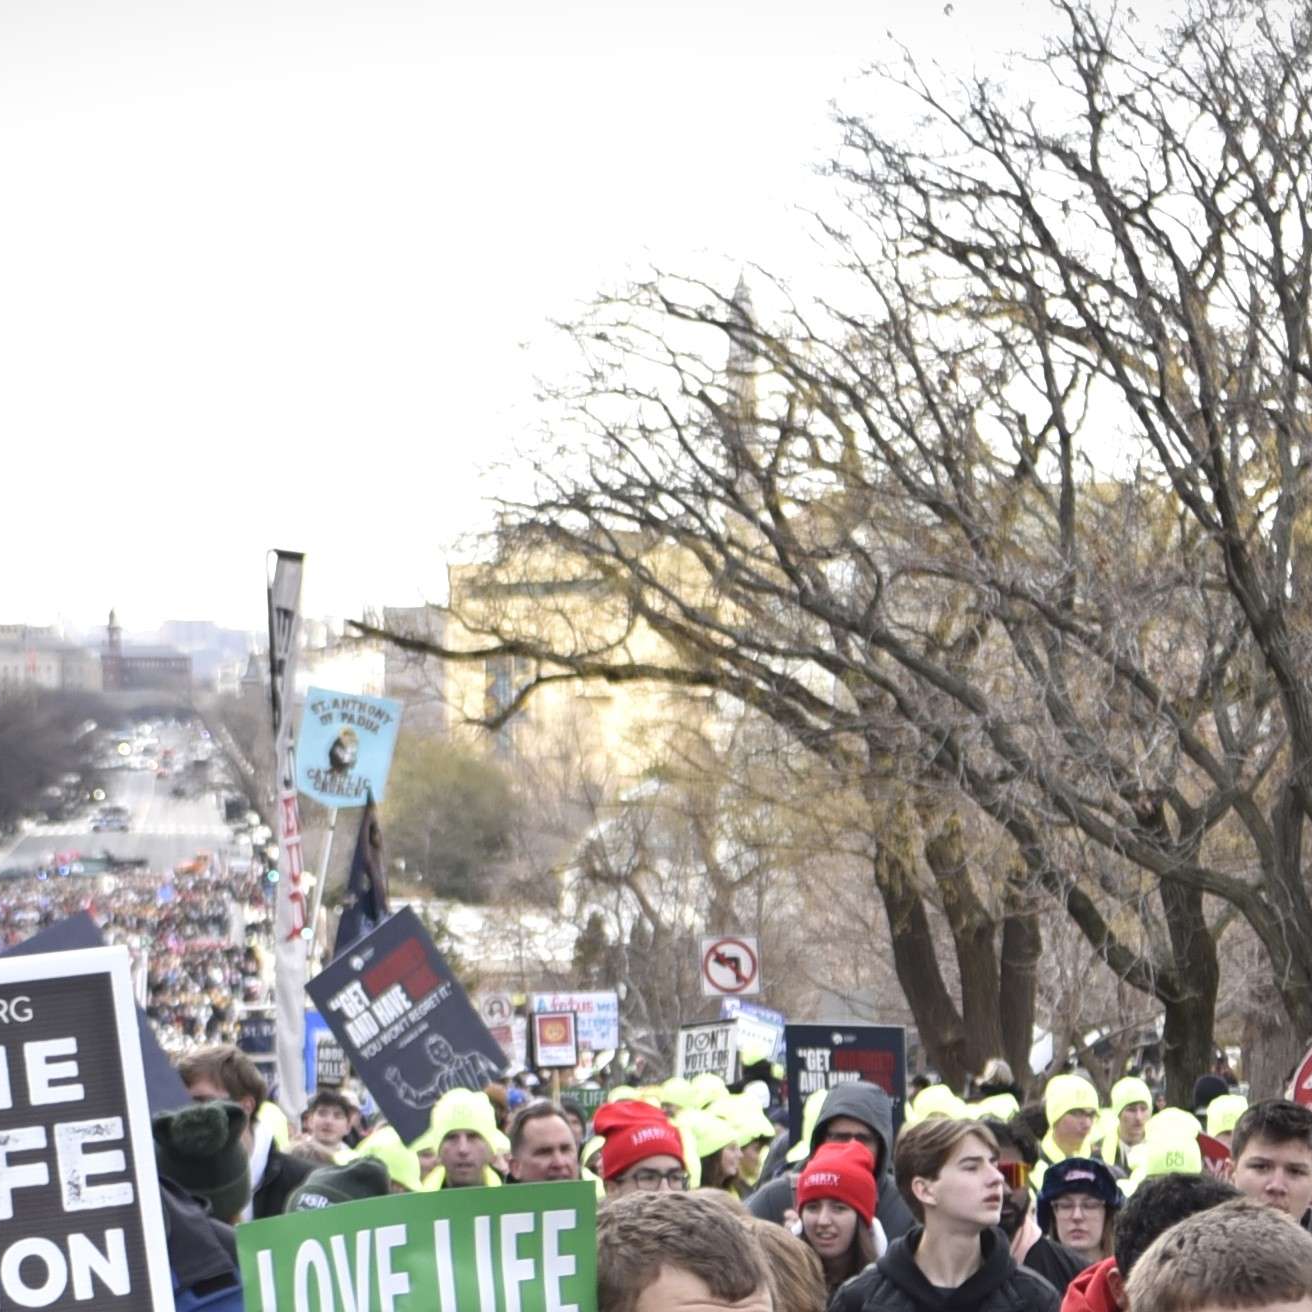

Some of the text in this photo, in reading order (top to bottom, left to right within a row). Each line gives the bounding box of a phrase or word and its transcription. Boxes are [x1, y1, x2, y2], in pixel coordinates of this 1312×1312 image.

[332, 698, 393, 725] ANTHONY
[340, 712, 380, 735] PADUA
[345, 1011, 380, 1049] AND
[799, 1071, 825, 1093] AND
